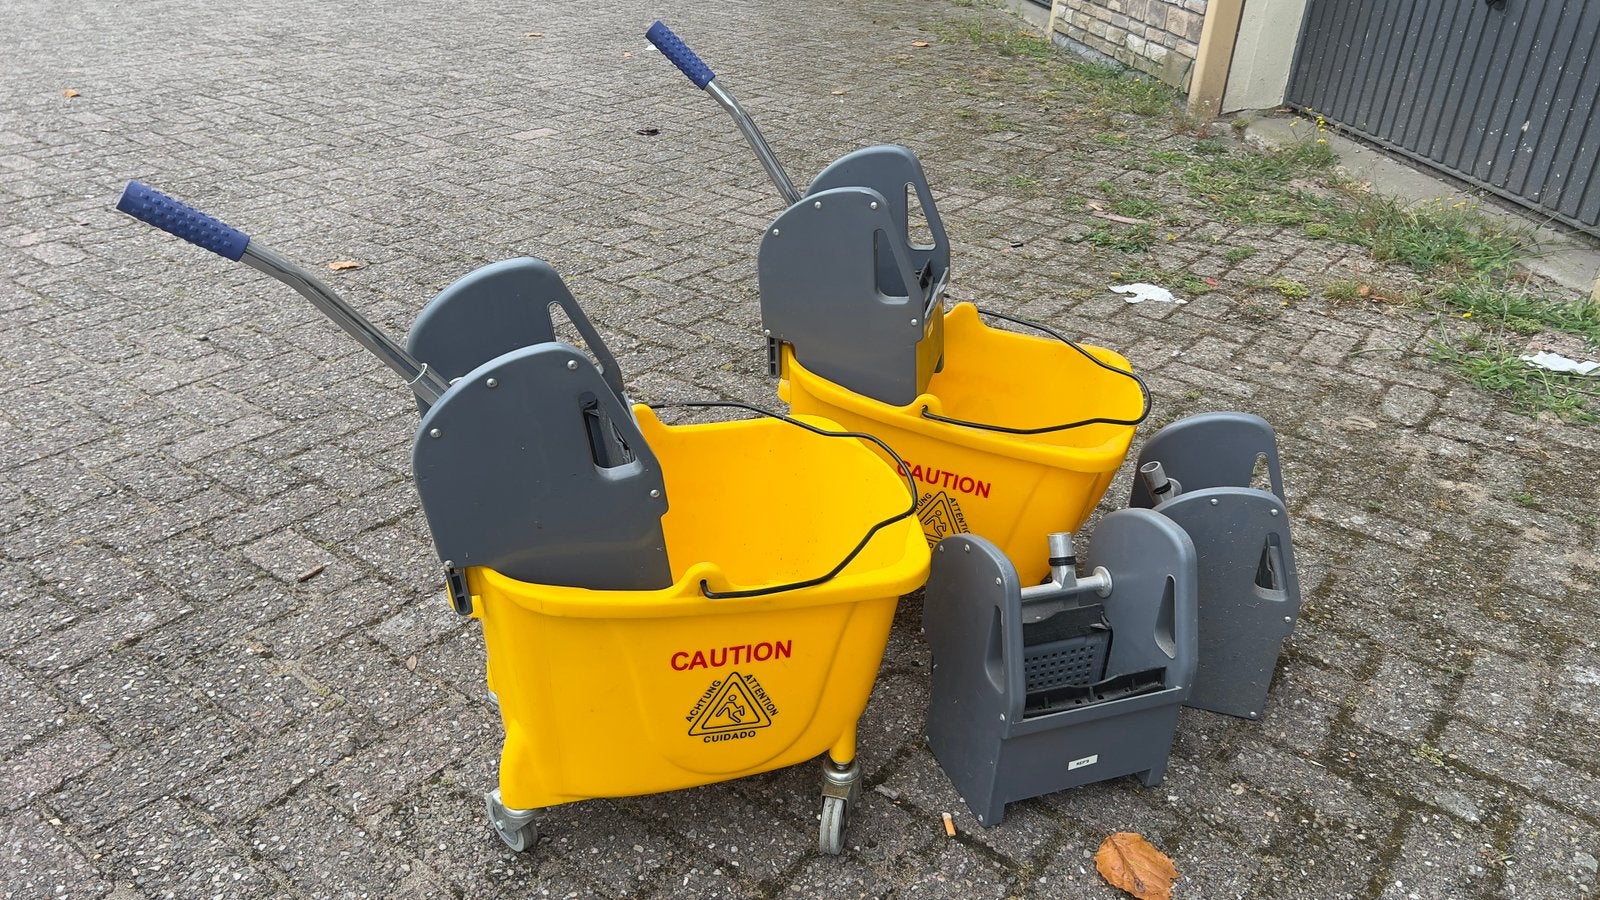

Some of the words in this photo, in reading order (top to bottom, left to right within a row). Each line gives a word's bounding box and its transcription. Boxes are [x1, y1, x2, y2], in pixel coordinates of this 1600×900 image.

[897, 460, 991, 498] CAUTION
[949, 497, 971, 534] ATTENTI
[671, 640, 792, 671] CAUTION
[685, 680, 722, 723] ACHTUNG
[743, 674, 779, 717] ATTENTION
[703, 730, 756, 743] CUIDADO
